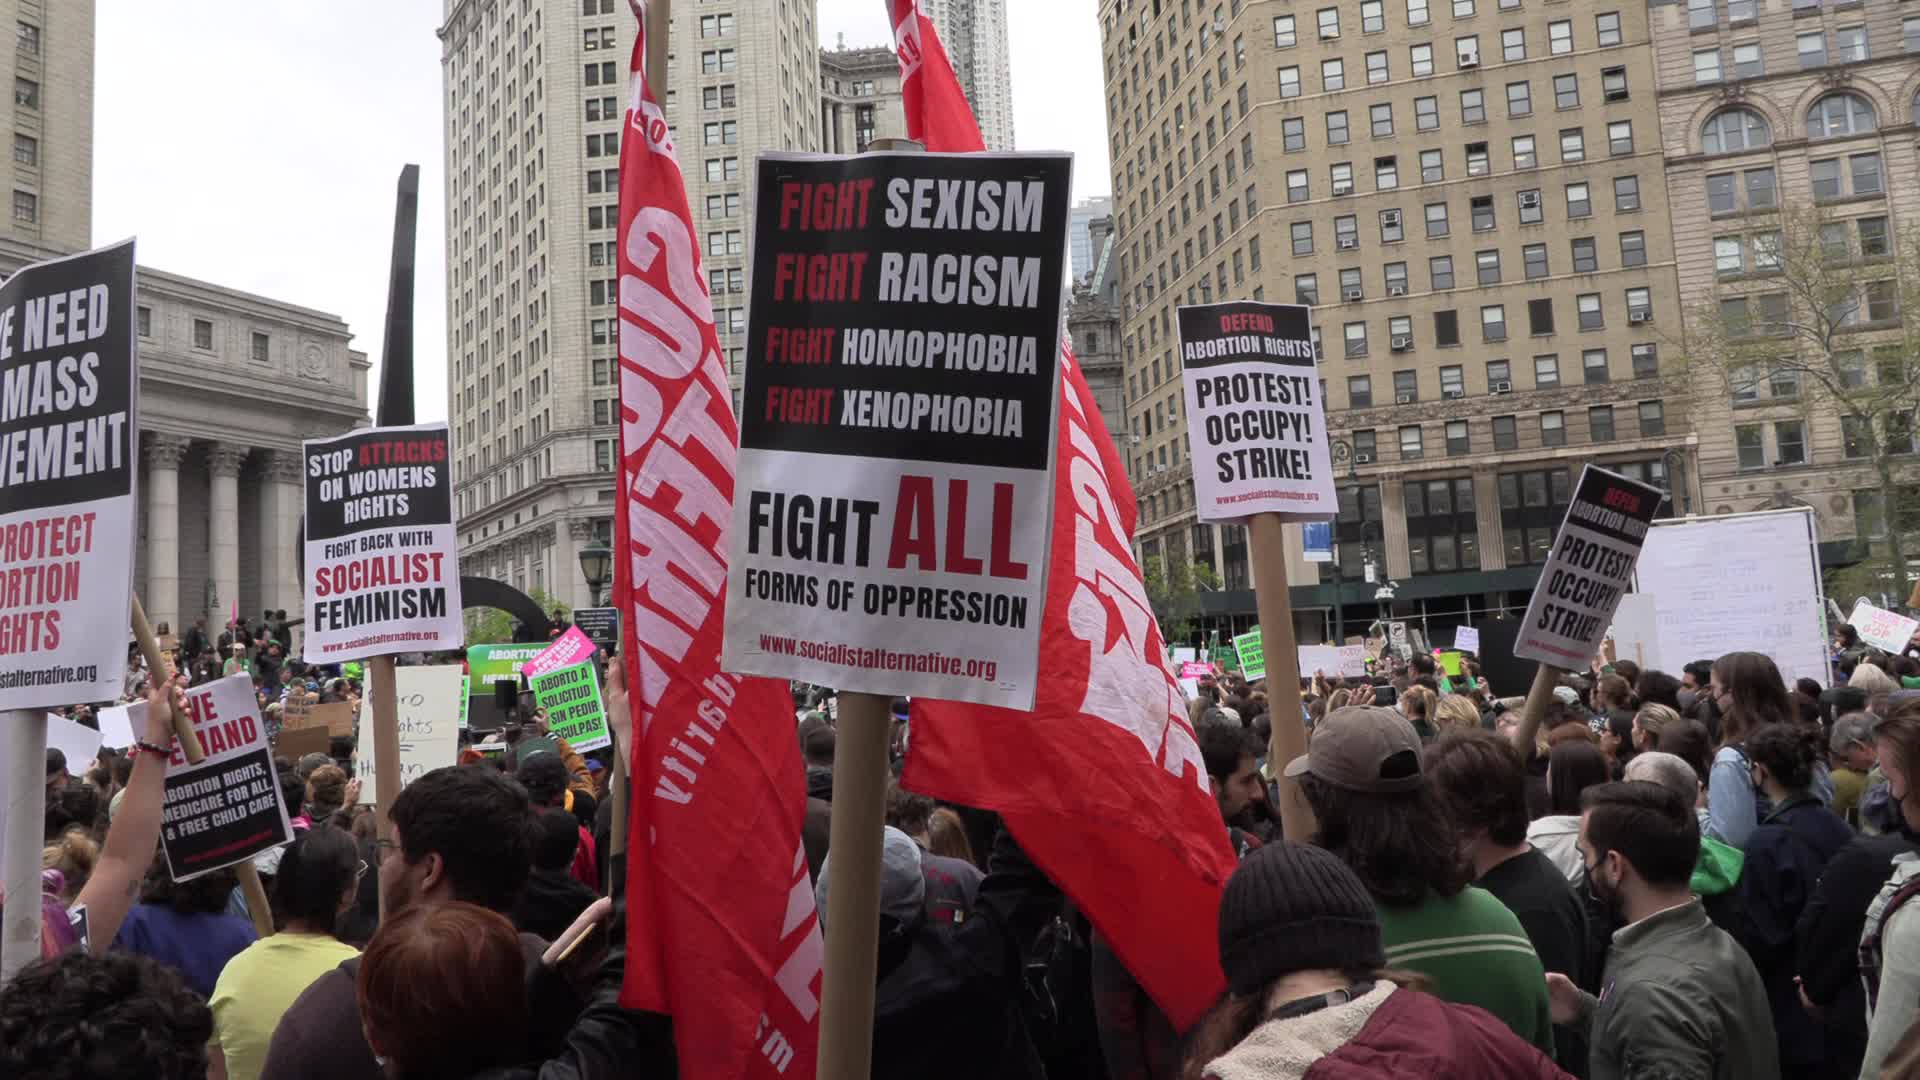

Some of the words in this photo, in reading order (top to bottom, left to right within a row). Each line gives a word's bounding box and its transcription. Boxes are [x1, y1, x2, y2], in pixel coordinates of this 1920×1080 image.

[779, 178, 874, 231] FIGHT
[885, 177, 1045, 232] SEXISM
[774, 253, 868, 301] FIGHT
[878, 252, 1041, 308] RACISM
[0, 304, 15, 361] E
[23, 283, 109, 352] NEED
[1220, 313, 1275, 333] DEFEND
[766, 326, 835, 365] FIGHT
[841, 328, 1037, 375] HOMOPHOBIA
[1185, 336, 1261, 360] ABORTION
[1264, 338, 1312, 358] RIGHTS
[1, 352, 100, 422] MASS
[1195, 372, 1312, 409] PROTEST!
[765, 386, 835, 425] FIGHT
[840, 389, 1023, 438] XENOPHOBIA
[1205, 409, 1313, 446] OCCUPY!
[309, 449, 353, 477] STOP
[360, 440, 446, 466] ATTACKS
[1216, 448, 1312, 483] STRIKE!
[320, 478, 343, 502] ON
[348, 466, 436, 496] WOMENS
[344, 493, 409, 524] RIGHTS
[748, 490, 880, 568] FIGHT
[887, 474, 1028, 580] ALL
[1572, 498, 1625, 530] ABORTION
[325, 539, 357, 559] FIGHT
[361, 533, 393, 552] BACK
[398, 530, 433, 547] WITH
[1558, 534, 1634, 581] PROTEST!
[315, 552, 444, 597] SOCIALIST
[1548, 569, 1620, 611] OCCUPY!
[314, 587, 447, 632] FEMINISM
[745, 568, 819, 607] FORMS
[827, 579, 854, 612] OF
[863, 583, 1028, 629] OPPRESSION
[323, 631, 438, 653] www.socialistalternative.org
[759, 633, 997, 682] www.socialistalternative.org
[581, 667, 588, 680] A
[541, 684, 591, 709] SOLICITUD
[550, 710, 567, 724] SIN
[569, 700, 598, 717] PEDIR
[161, 793, 225, 824] MEDICARE
[226, 788, 249, 806] FOR
[166, 827, 176, 840] &
[178, 816, 210, 837] FREE
[212, 804, 248, 827] CHILD
[249, 794, 276, 816] CARE
